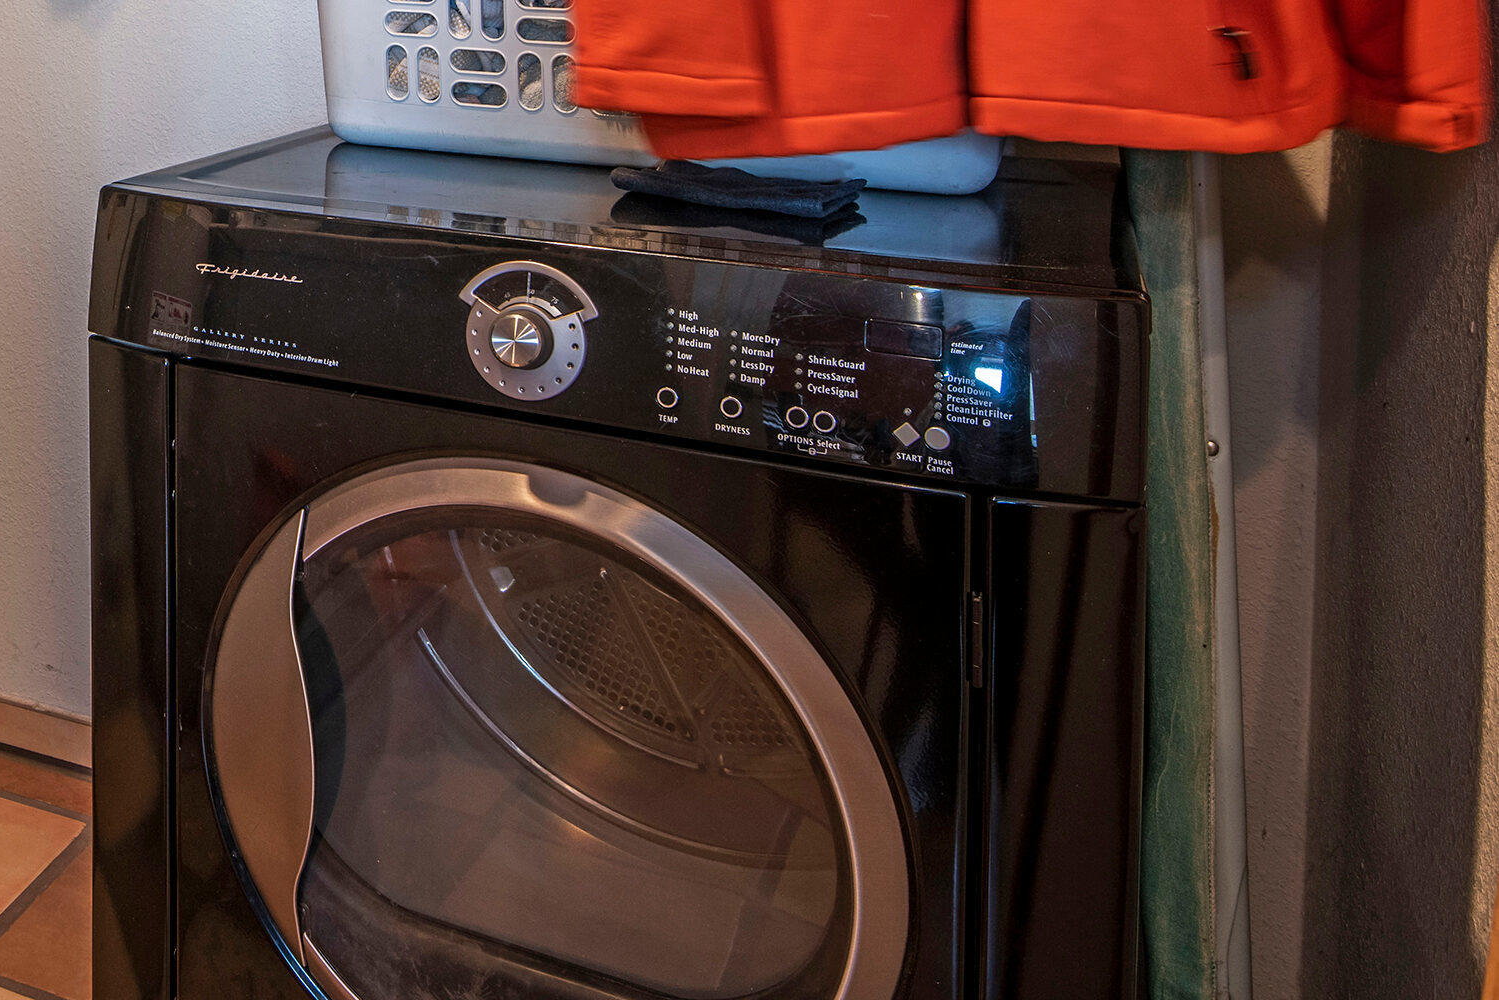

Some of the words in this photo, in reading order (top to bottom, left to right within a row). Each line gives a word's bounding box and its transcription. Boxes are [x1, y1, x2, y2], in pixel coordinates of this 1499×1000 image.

[196, 263, 303, 284] Frigidaire
[551, 296, 559, 304] 75
[679, 310, 699, 321] High
[678, 324, 719, 337] Med-High
[193, 326, 245, 339] GALLERY
[254, 336, 297, 348] SERIES
[152, 329, 175, 339] Balanced
[175, 333, 185, 343] Dry
[184, 335, 200, 344] System
[205, 339, 228, 349] Moisture
[228, 343, 245, 352] Sensor
[250, 347, 267, 356] Heavy
[267, 349, 280, 359] Duty
[284, 352, 307, 362] Interior
[307, 356, 323, 364] Drum
[323, 358, 339, 367] Light
[678, 338, 712, 349] Medium
[951, 342, 983, 350] estimated
[677, 351, 693, 360] Low
[741, 346, 774, 358] Normal
[740, 374, 766, 386] Damp
[947, 375, 976, 387] Drying
[947, 384, 966, 394] Cool
[967, 387, 991, 397] Down
[947, 395, 968, 404] Press
[970, 398, 993, 408] Saver
[947, 404, 970, 414] Clean
[971, 407, 988, 417] Lint
[989, 409, 1013, 420] Filter
[658, 414, 679, 423] TEMP
[947, 414, 978, 425] Control
[715, 424, 751, 436] DRYNESS
[778, 433, 814, 445] OPTIONS
[816, 439, 840, 450] Select
[896, 452, 923, 462] START
[928, 457, 953, 467] Pause
[927, 464, 954, 474] Cancel
